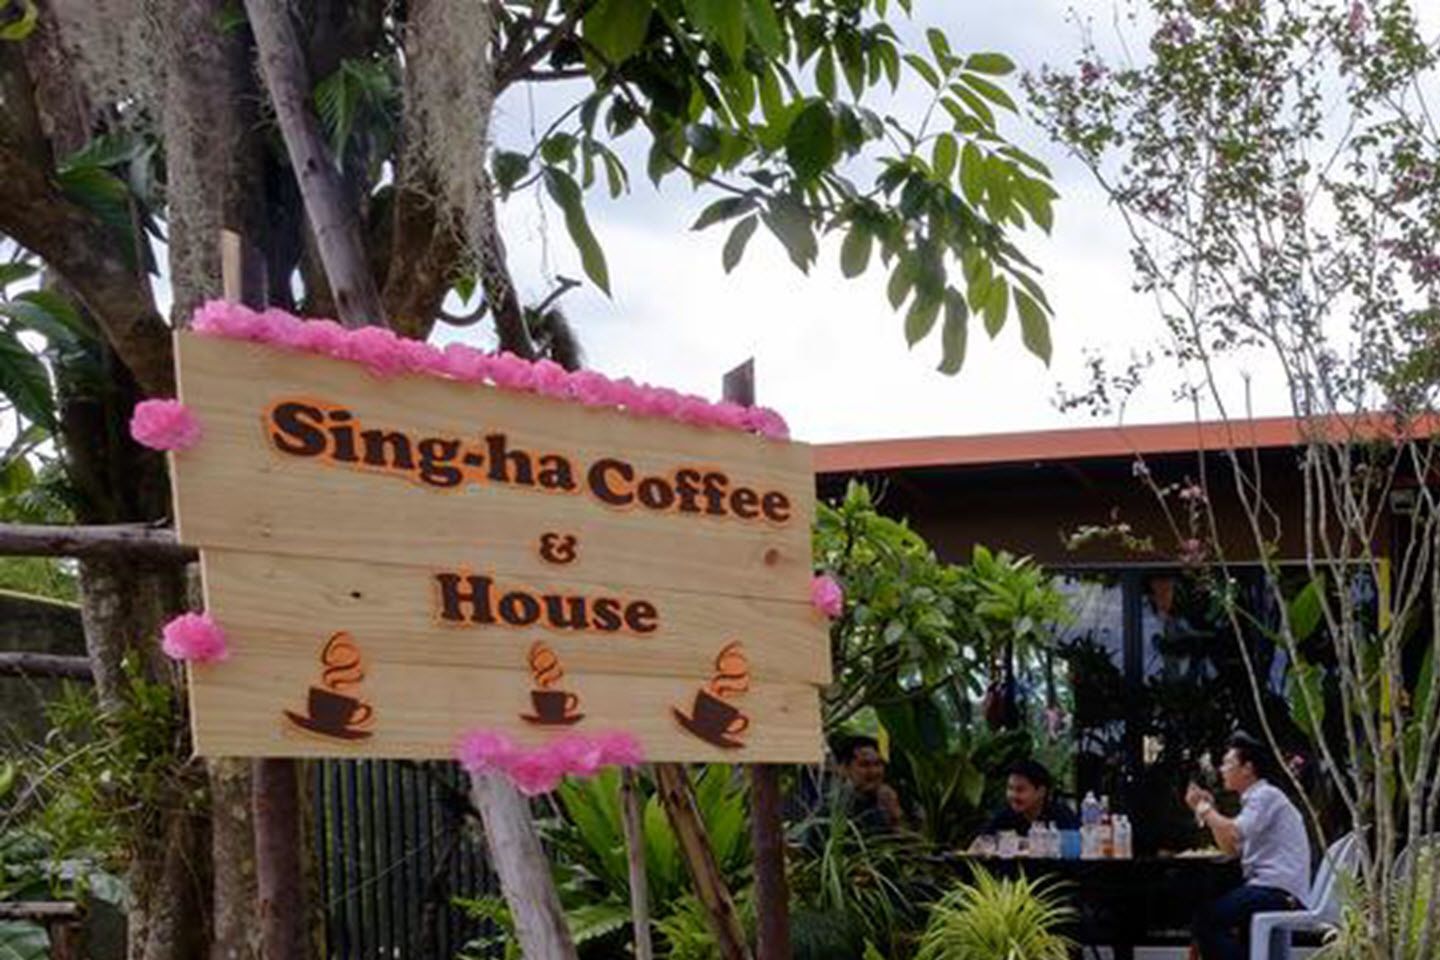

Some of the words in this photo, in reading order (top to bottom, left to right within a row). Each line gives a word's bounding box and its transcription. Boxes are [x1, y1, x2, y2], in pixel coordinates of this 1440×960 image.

[270, 400, 577, 488] Sing-ha
[586, 457, 792, 523] Coffee
[539, 531, 578, 565] &
[434, 572, 659, 633] House
